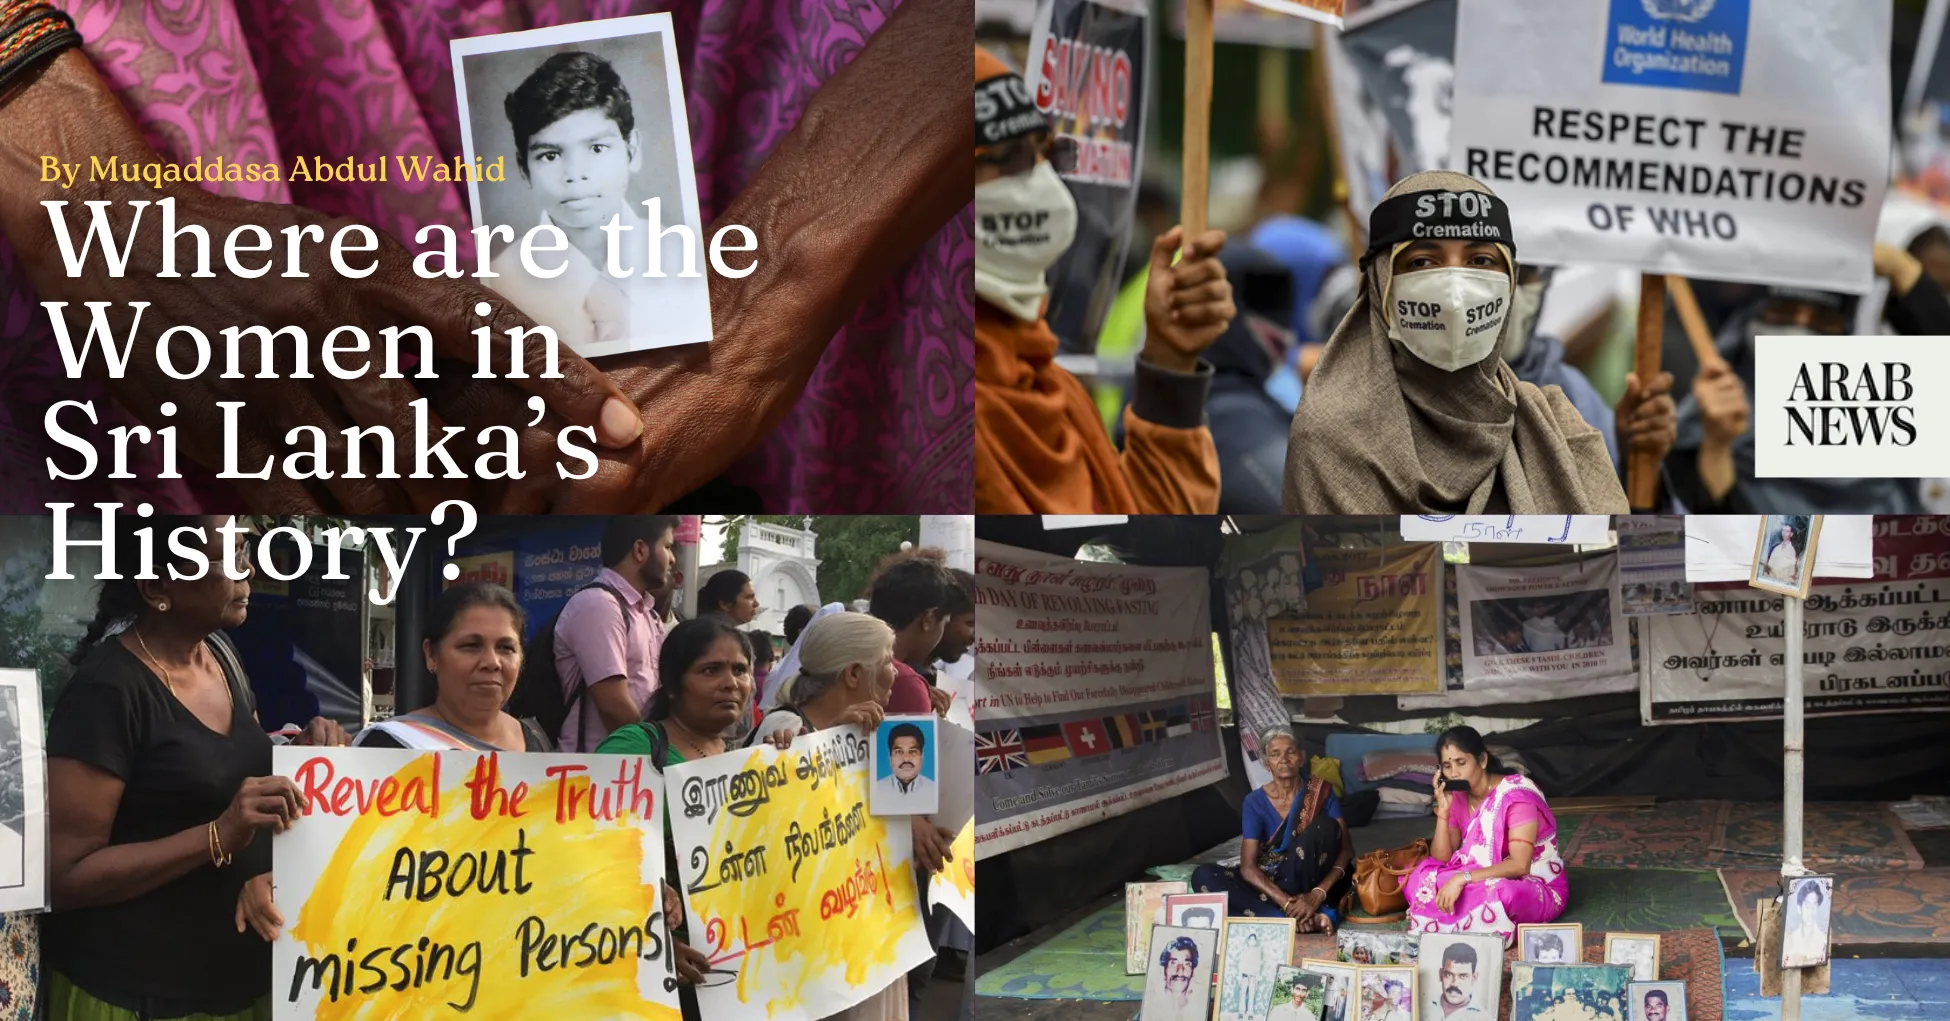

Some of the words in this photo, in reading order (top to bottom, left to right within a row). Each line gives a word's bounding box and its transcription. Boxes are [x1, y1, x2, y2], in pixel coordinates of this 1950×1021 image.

[1617, 24, 1667, 48] World
[1670, 28, 1734, 56] Health
[1612, 45, 1731, 79] Organization
[1090, 45, 1132, 128] NO
[1531, 106, 1707, 150] RESPECT
[1720, 122, 1806, 159] THE
[1466, 148, 1867, 208] RECOMMENDATIONS
[1415, 192, 1492, 218] STOP
[982, 210, 1050, 232] STOP
[1412, 221, 1501, 238] Cremation
[1587, 203, 1635, 234] OF
[1647, 206, 1738, 241] WHO
[1398, 300, 1441, 318] STOP
[1466, 297, 1503, 324] STOP
[1400, 318, 1446, 331] Cremation
[1465, 316, 1502, 337] Cremation
[985, 586, 1016, 608] DAY
[1018, 590, 1037, 610] OF
[1041, 592, 1114, 615] REVOLVING
[1115, 597, 1160, 616] FASTING
[974, 637, 1021, 657] க்கப்பட்ட
[1536, 653, 1562, 664] TAMIL
[1563, 650, 1606, 661] CHILDREN
[1663, 647, 1763, 671] அவர்கள்
[1768, 650, 1837, 668] எபடி
[1529, 664, 1550, 672] WITH
[1551, 662, 1568, 671] YOU
[1571, 662, 1582, 670] IN
[989, 695, 1000, 707] in
[1000, 692, 1014, 707] UN
[1014, 694, 1024, 706] to
[1024, 691, 1043, 707] Help
[1043, 693, 1052, 704] to
[1052, 689, 1069, 703] Find
[1070, 688, 1085, 701] Our
[295, 752, 441, 819] Reveal
[465, 751, 529, 821] the
[545, 757, 655, 825] Truth
[681, 760, 788, 825] இராணுவ
[992, 795, 1018, 812] Come
[1021, 788, 1037, 805] and
[705, 891, 800, 966] உடன்
[288, 936, 483, 1014] missing
[515, 877, 679, 995] Persons!
